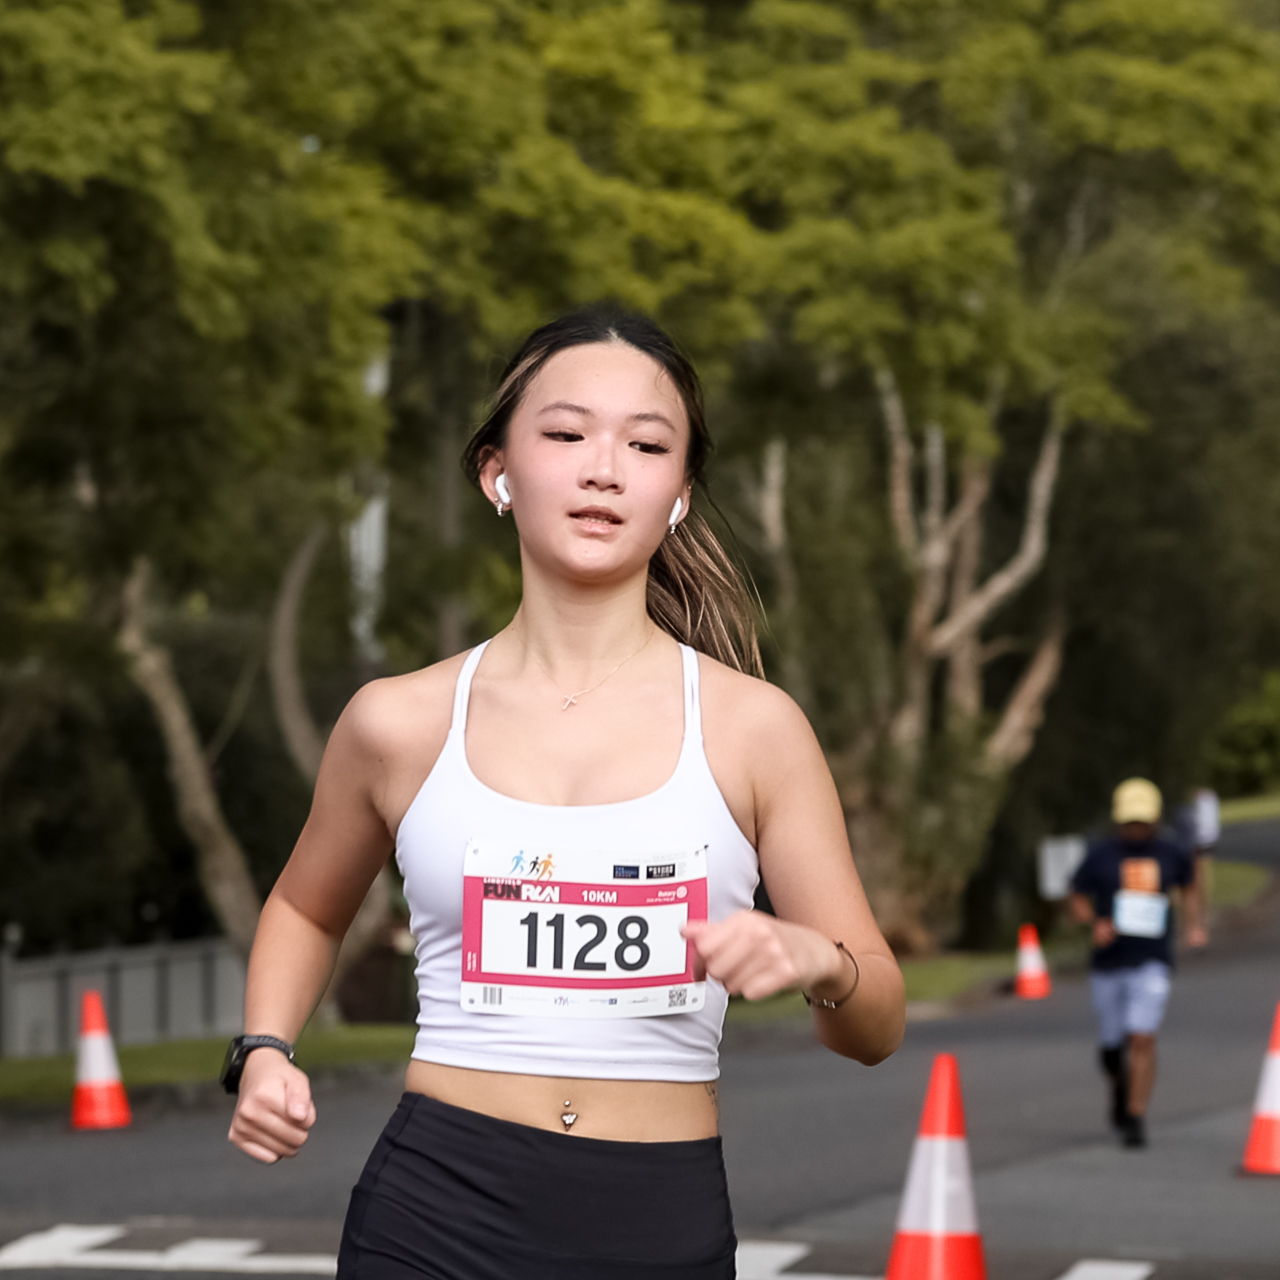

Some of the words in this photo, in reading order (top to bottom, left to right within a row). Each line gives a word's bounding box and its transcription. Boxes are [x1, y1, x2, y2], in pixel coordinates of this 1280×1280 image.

[483, 883, 521, 899] FUN
[581, 889, 617, 903] 10KM
[520, 911, 651, 972] 1128
